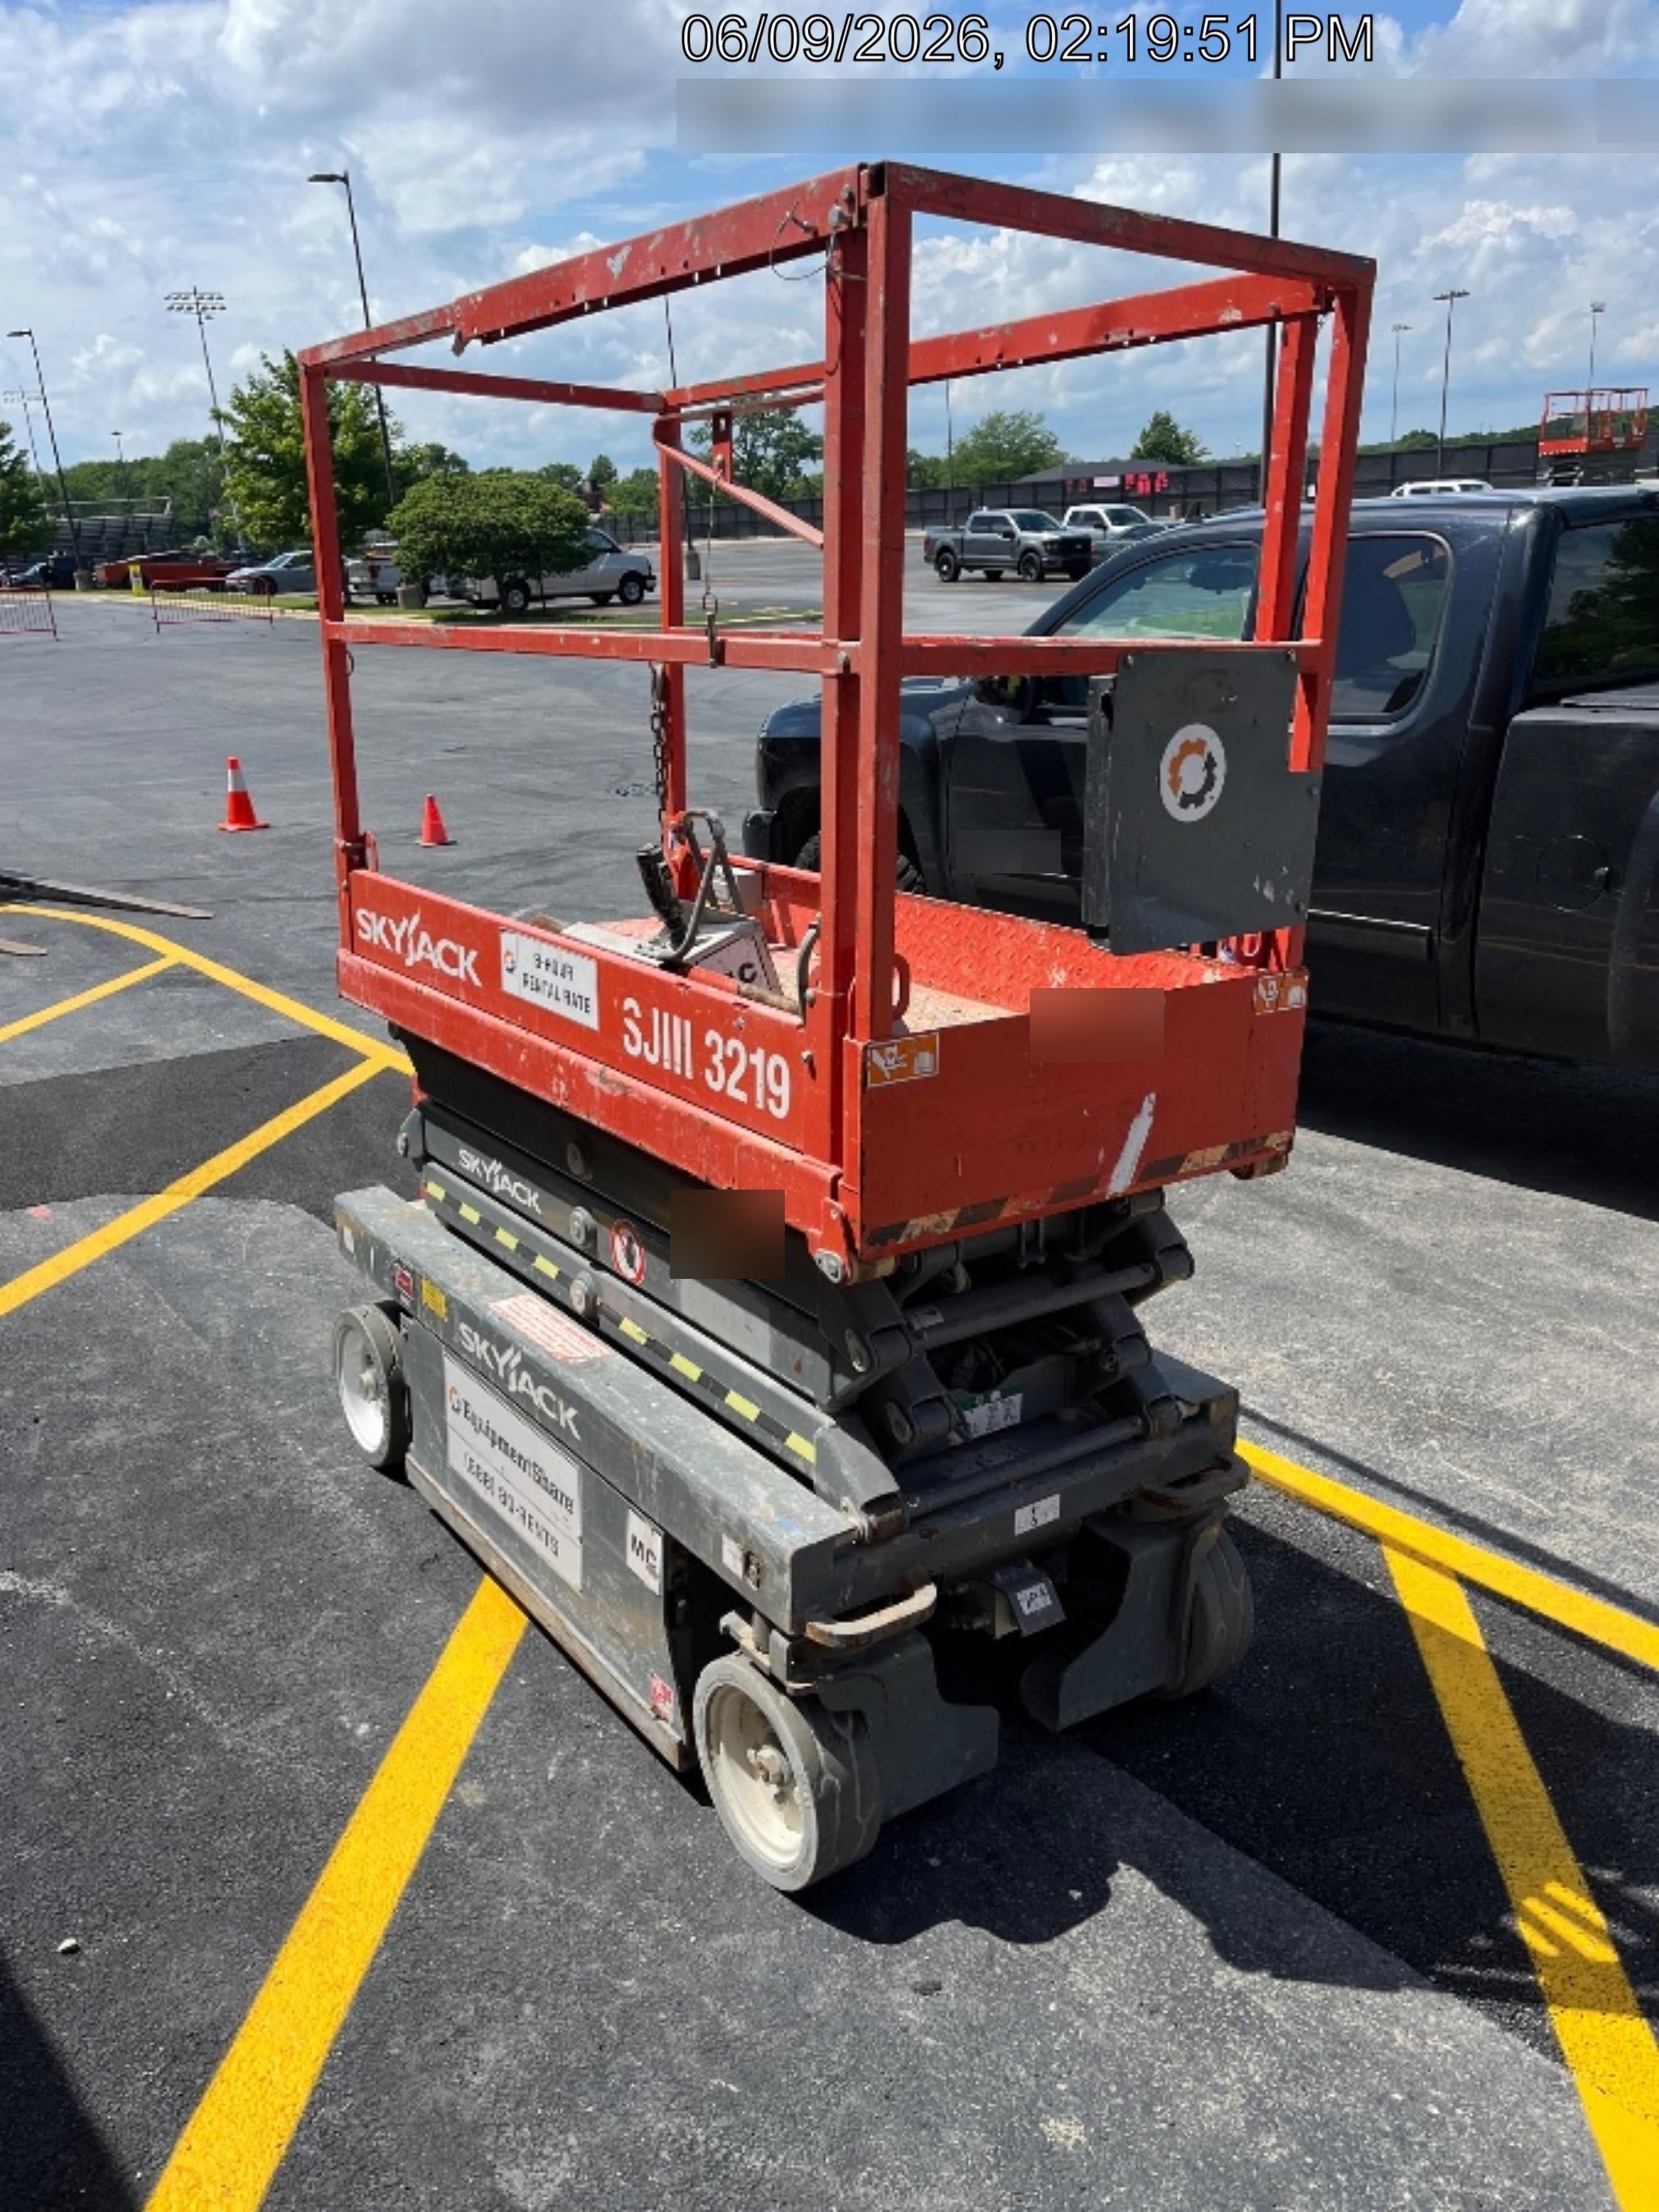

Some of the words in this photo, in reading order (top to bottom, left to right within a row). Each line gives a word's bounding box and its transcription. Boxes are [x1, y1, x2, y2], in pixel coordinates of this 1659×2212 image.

[355, 904, 483, 988] SKYJACK
[623, 997, 694, 1080] SJIII
[705, 1029, 790, 1119] 3219
[459, 1149, 542, 1215] SKYJACK
[459, 1321, 581, 1442] SKYJACK
